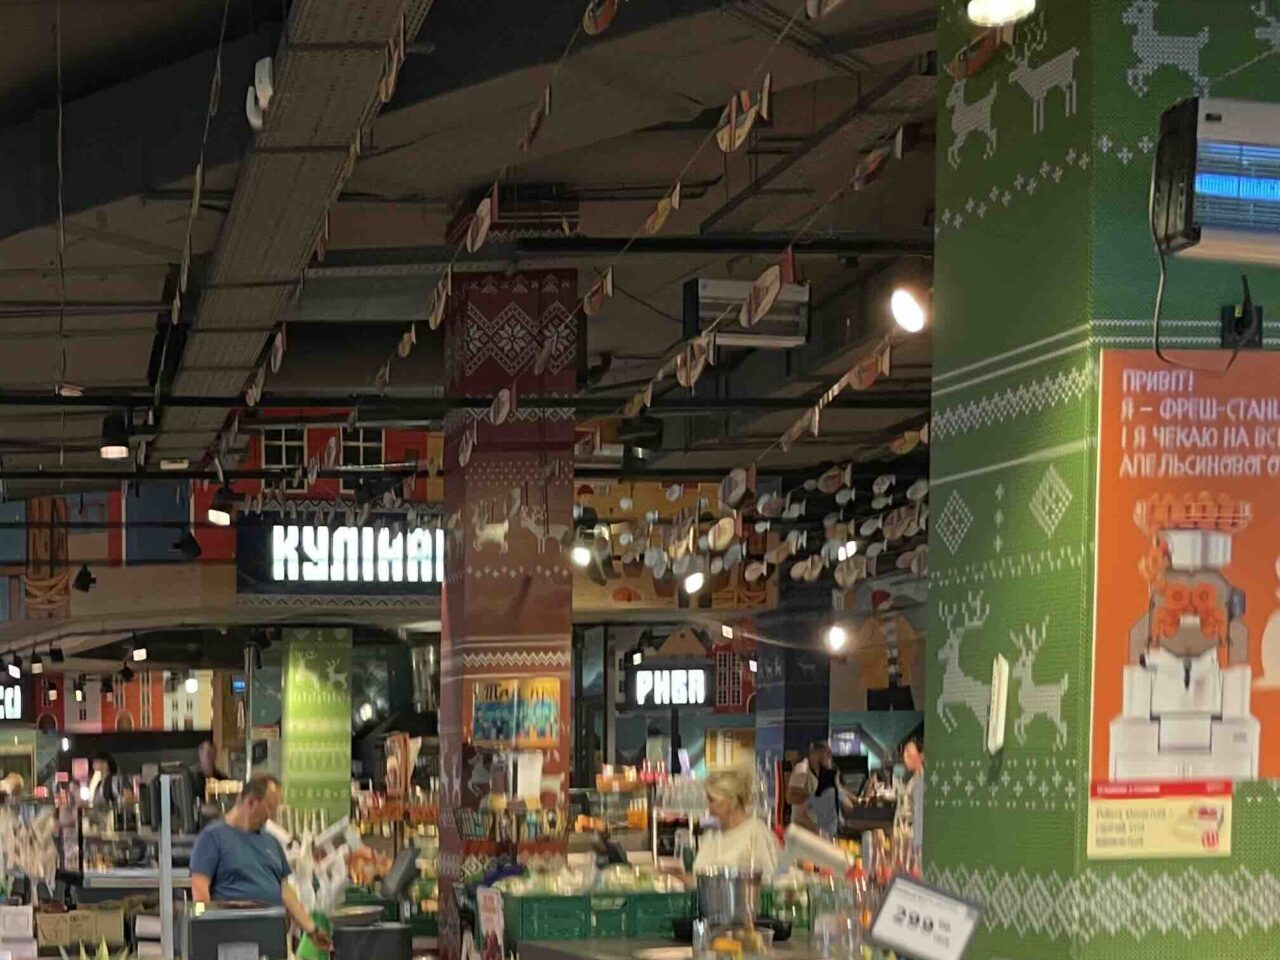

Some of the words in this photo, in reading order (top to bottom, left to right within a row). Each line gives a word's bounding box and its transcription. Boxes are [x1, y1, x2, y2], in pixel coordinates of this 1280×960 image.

[1122, 369, 1194, 393] ПРИВІТ!
[1121, 397, 1134, 421] Я
[1133, 426, 1146, 449] Я
[1152, 426, 1219, 449] ЧЕКАЮ
[1223, 426, 1250, 449] НА
[1119, 453, 1280, 479] АПЕЛЬСИНОВОГО
[636, 669, 706, 706] РИБА
